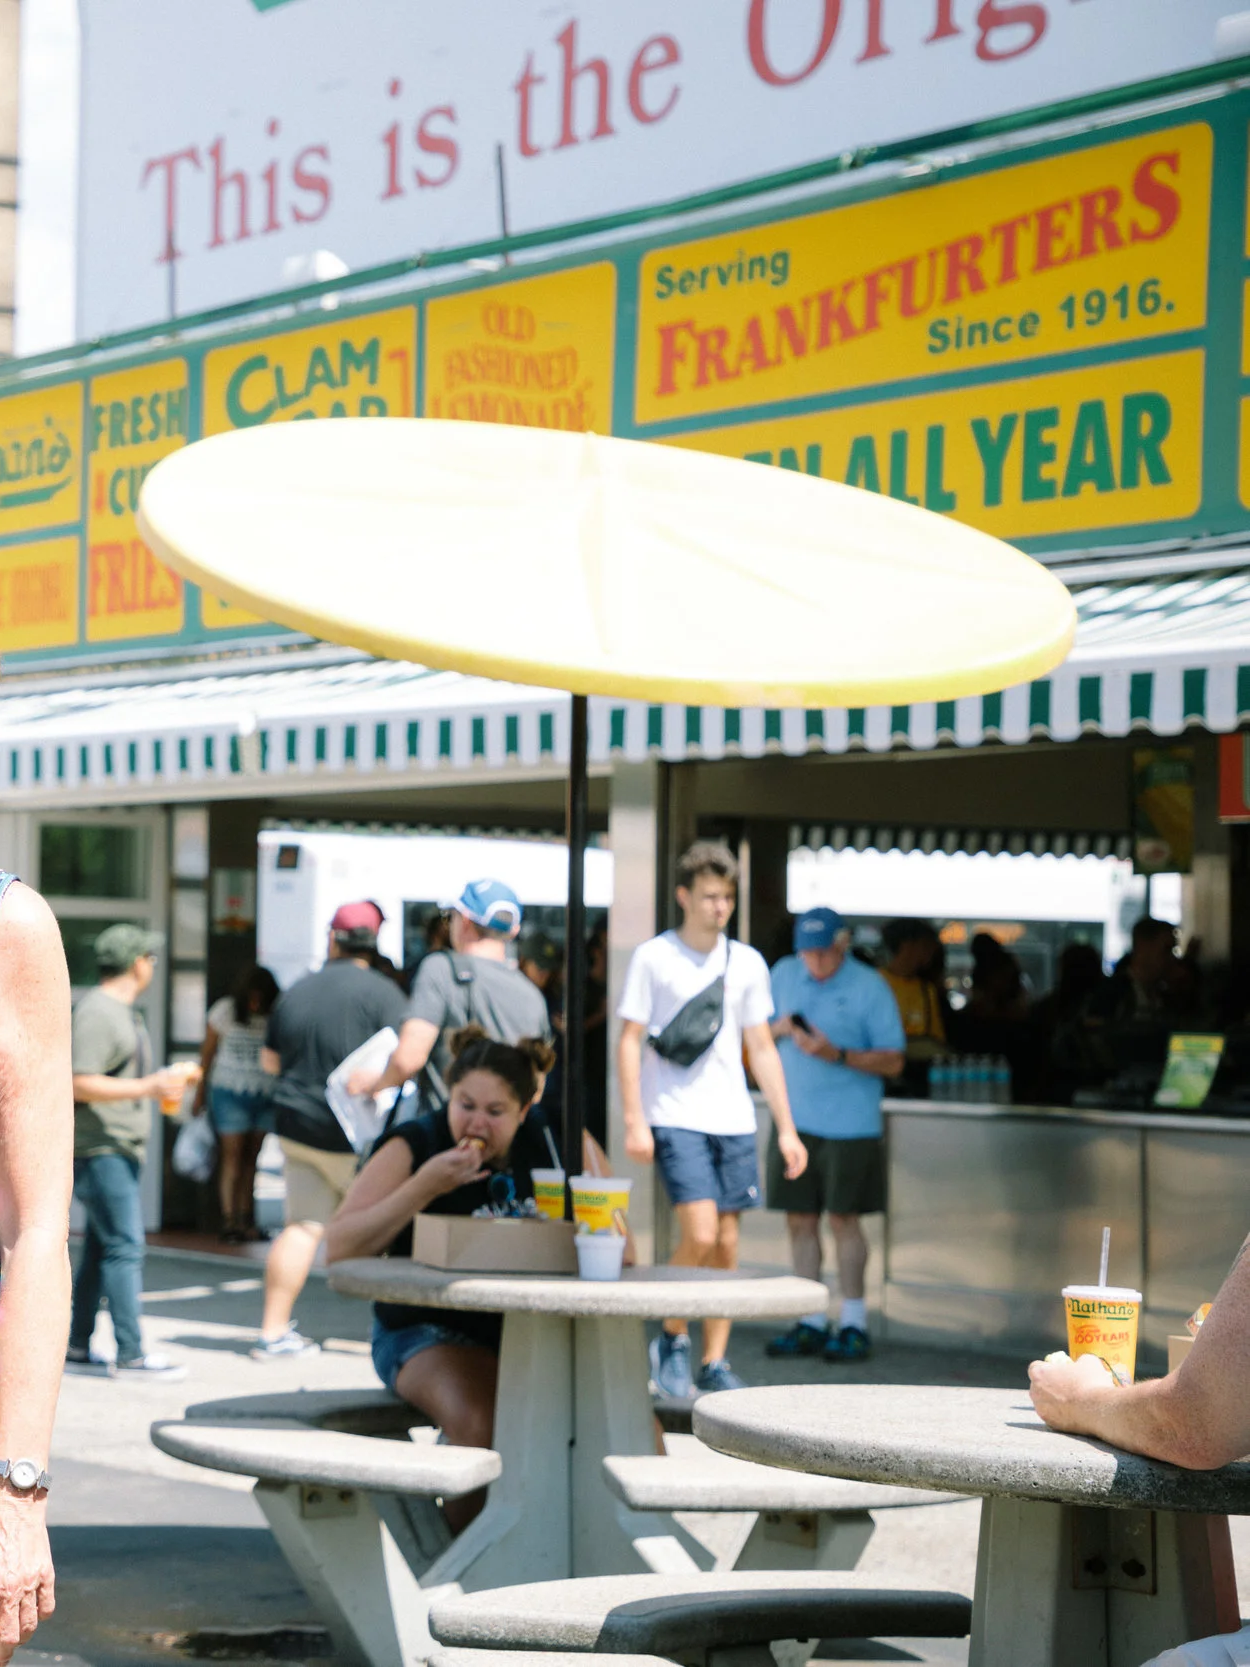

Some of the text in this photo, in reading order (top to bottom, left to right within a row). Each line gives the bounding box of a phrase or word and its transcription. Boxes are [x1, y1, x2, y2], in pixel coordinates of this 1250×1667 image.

[138, 118, 334, 264] This
[380, 78, 461, 202] is
[513, 19, 682, 159] the
[653, 150, 1183, 398] FRANKFURTERS
[655, 250, 790, 300] Serving
[481, 300, 537, 344] OLD
[927, 278, 1176, 355] Since 1916.
[226, 336, 381, 429] CLAM
[444, 342, 579, 392] FASHIONED
[86, 388, 188, 453] FRESH
[836, 390, 1173, 514] ALL YEAR
[1068, 1297, 1135, 1316] Nathan's
